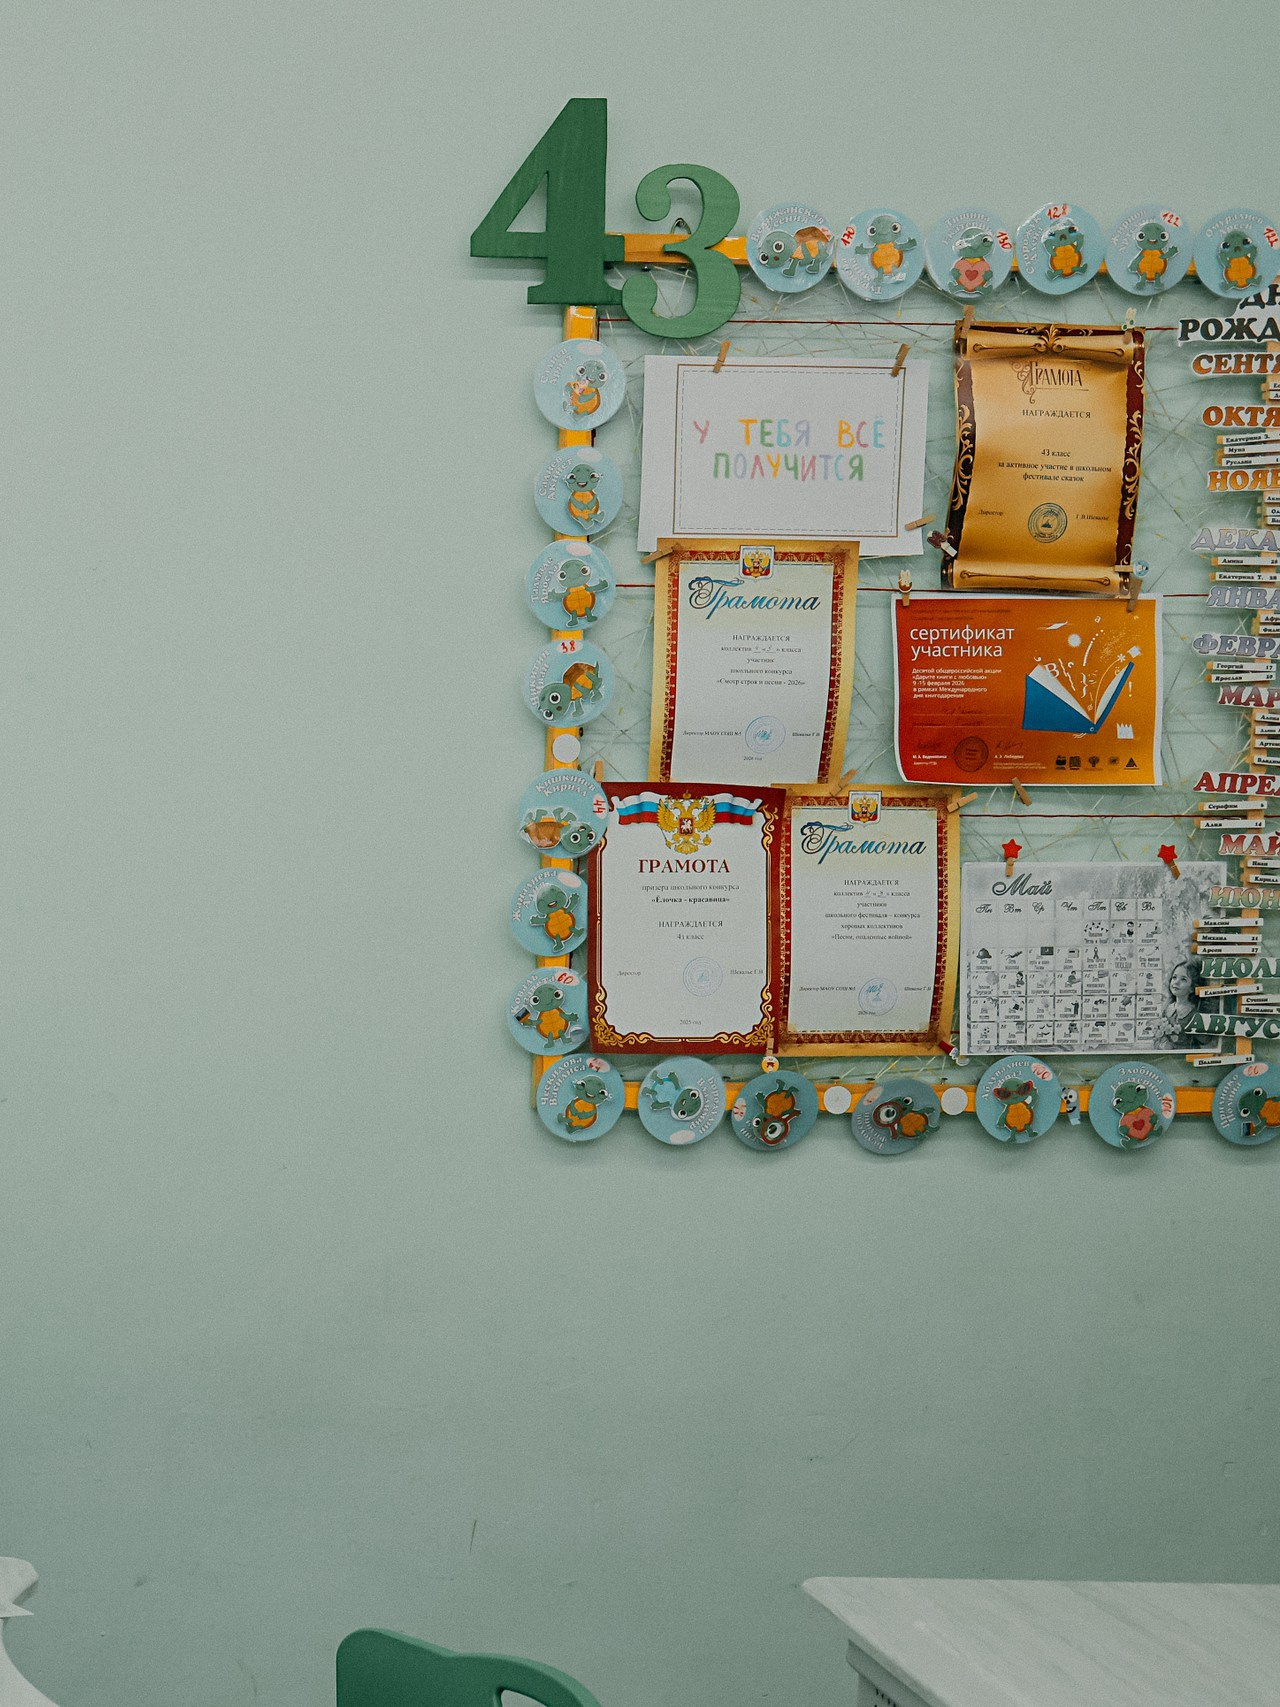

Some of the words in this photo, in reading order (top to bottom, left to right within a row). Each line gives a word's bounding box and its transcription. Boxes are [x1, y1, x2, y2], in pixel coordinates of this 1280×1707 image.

[1021, 408, 1092, 419] НАГРАЖДАЕТСЯ
[692, 420, 710, 445] У
[738, 418, 811, 448] ТЕБЯ
[837, 416, 886, 449] ВСЁ
[1051, 450, 1071, 458] класс
[712, 452, 865, 483] ПОЛУЧИТСЯ
[1005, 461, 1040, 471] активное
[1040, 463, 1069, 472] участие
[1075, 465, 1112, 474] школьном
[1022, 473, 1061, 483] фестивале
[1061, 474, 1085, 482] сказок
[688, 576, 821, 620] Грамота
[732, 634, 791, 642] НАГРАЖДАЕТСЯ
[909, 624, 1015, 648] сертификат
[911, 643, 1004, 662] участника
[764, 668, 794, 676] конкурса
[927, 680, 951, 688] февраля
[938, 686, 988, 694] Международного
[800, 821, 927, 864] Грамота
[638, 858, 731, 874] ГРАМОТА
[843, 879, 900, 887] НАГРАЖДАЕТСЯ
[992, 873, 1053, 897] Май
[708, 884, 740, 893] конкурса
[893, 912, 921, 920] конкурса
[658, 920, 724, 929] НАГРАЖДАЕТСЯ
[686, 933, 705, 941] класс
